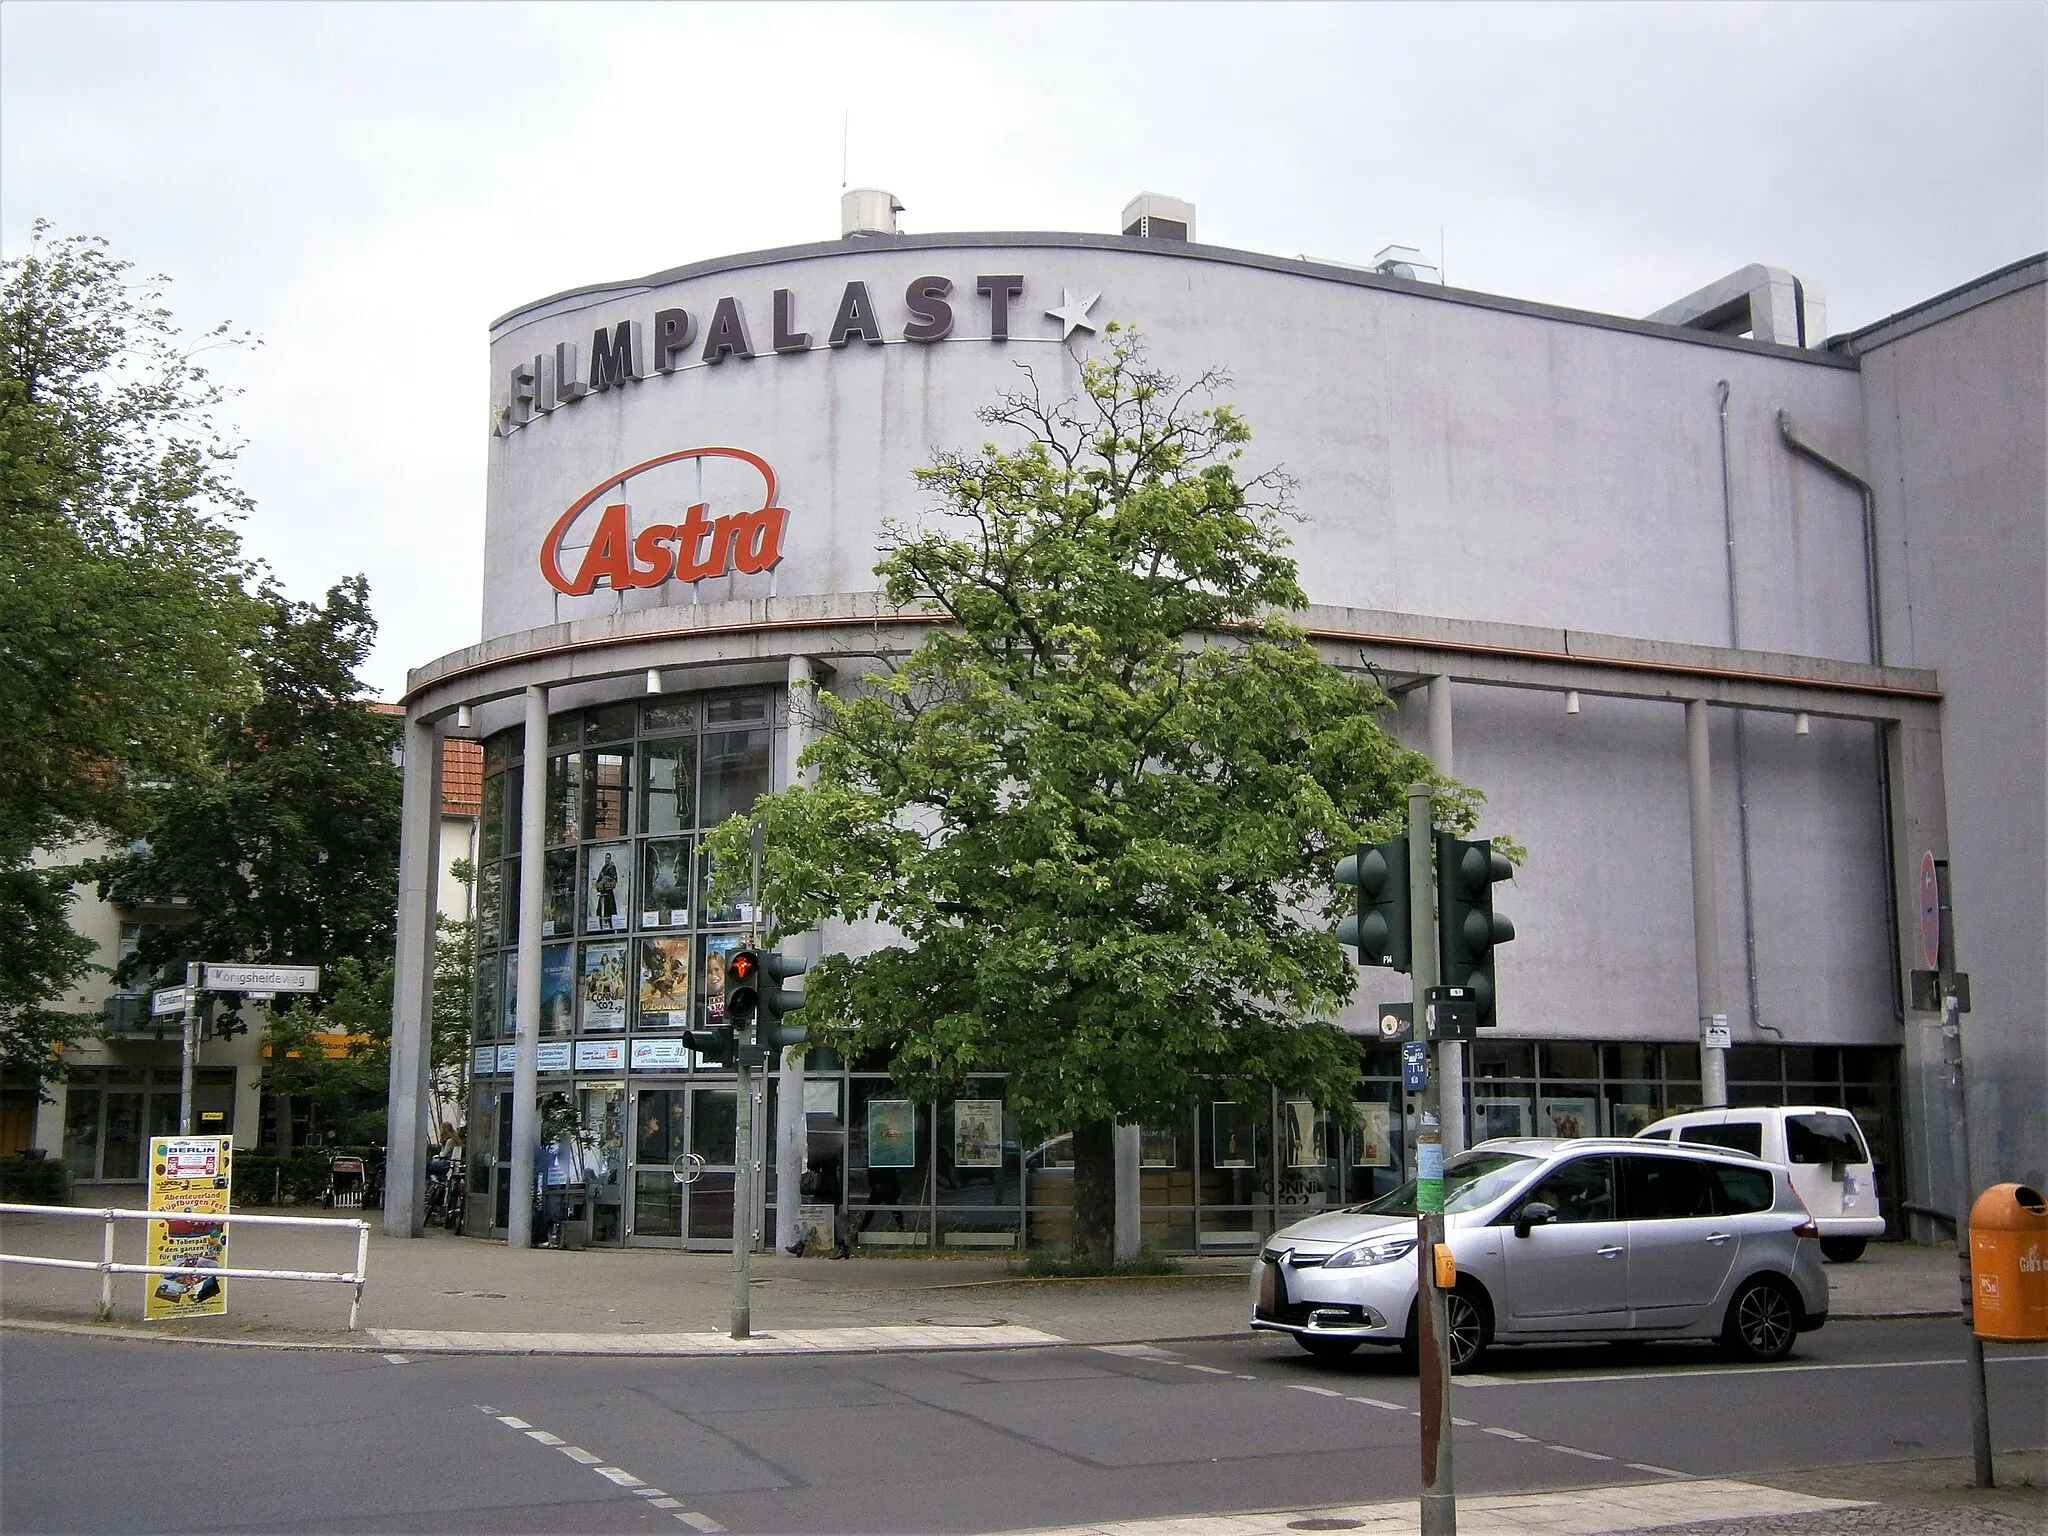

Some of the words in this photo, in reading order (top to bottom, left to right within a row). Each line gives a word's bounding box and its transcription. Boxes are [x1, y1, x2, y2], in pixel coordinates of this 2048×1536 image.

[509, 274, 1024, 426] FILMPALAST
[560, 502, 791, 597] Astra
[164, 1192, 221, 1201] Abenteuerland
[210, 1200, 227, 1211] Fest
